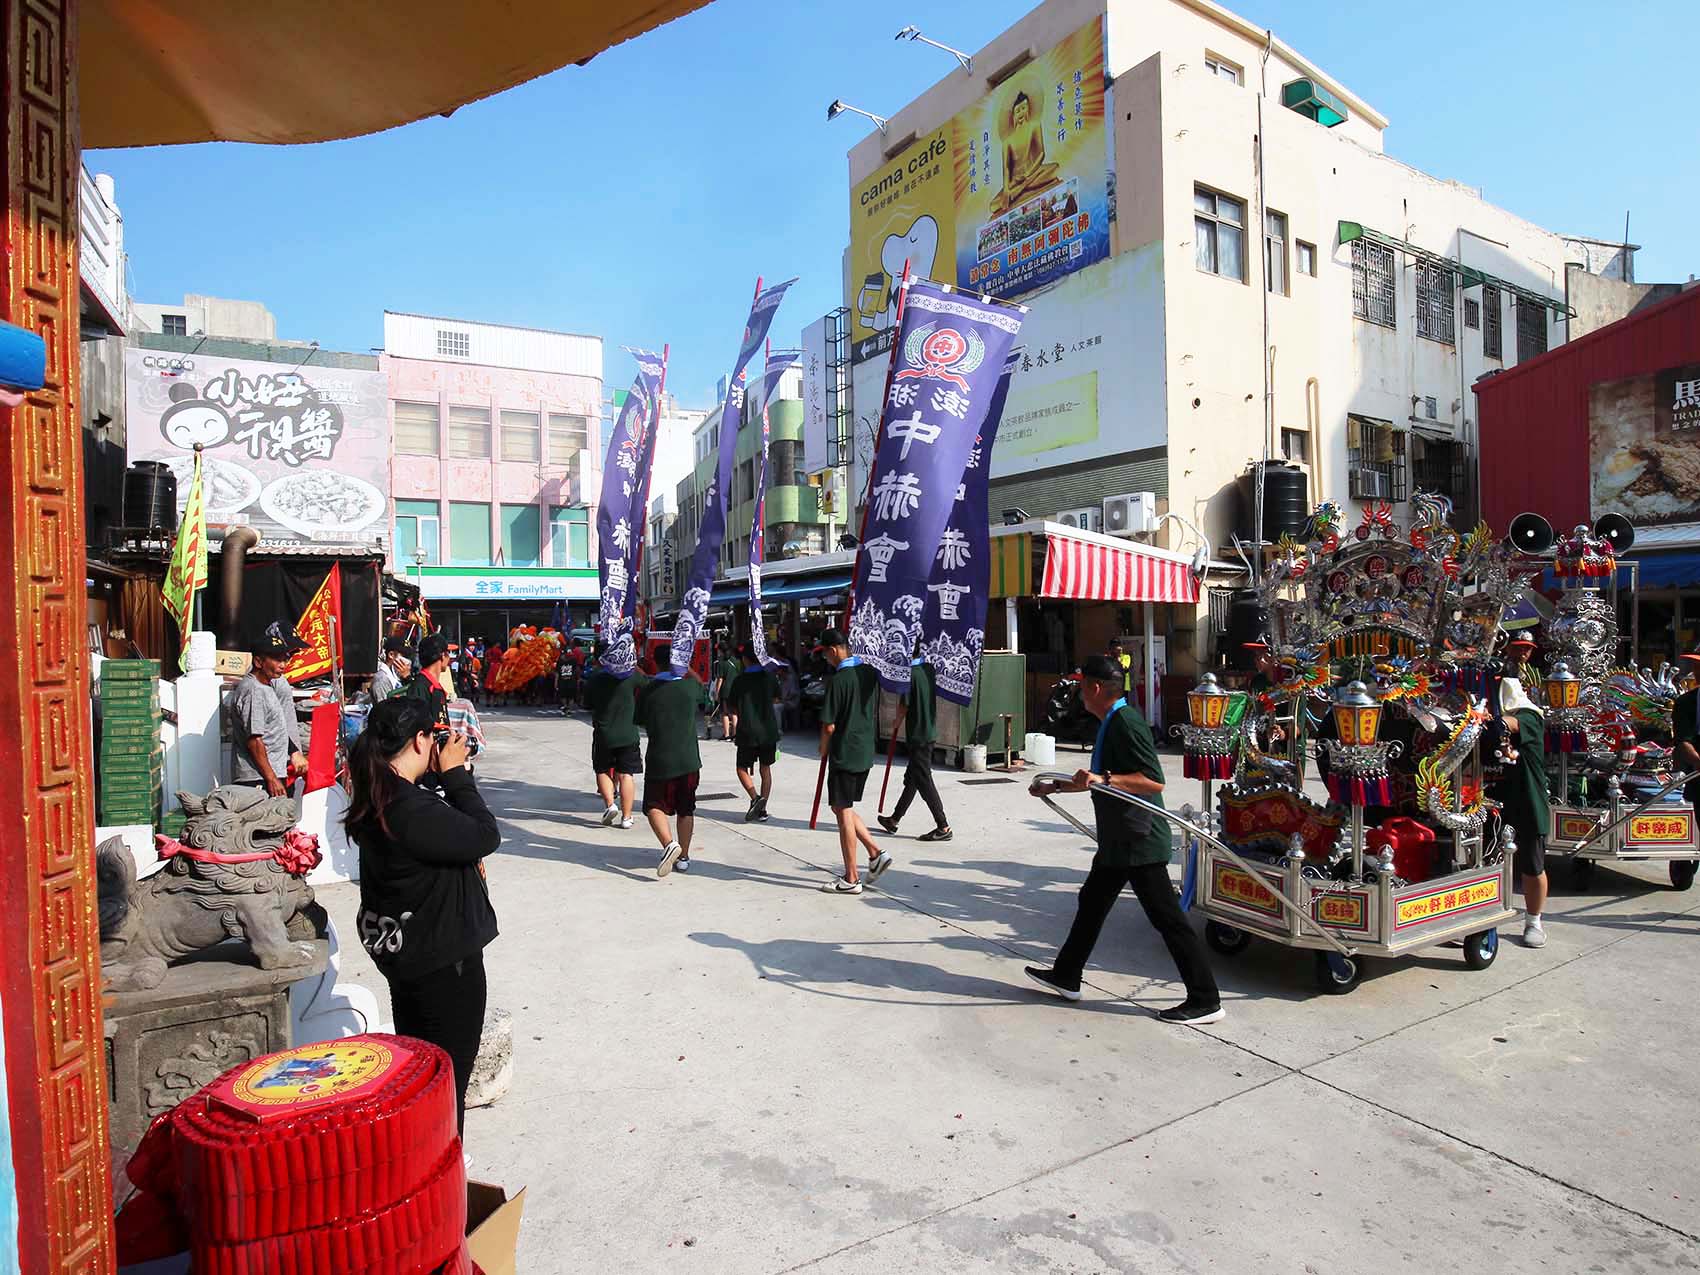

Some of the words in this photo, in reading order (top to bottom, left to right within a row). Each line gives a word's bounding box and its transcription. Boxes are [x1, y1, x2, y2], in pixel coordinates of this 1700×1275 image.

[861, 168, 903, 206] cama
[908, 131, 946, 174] café
[1008, 212, 1089, 265] 南無阿彌陀佛
[1021, 343, 1065, 372] 春水堂
[233, 407, 339, 465] 干貝醬
[475, 581, 503, 594] 全家
[508, 584, 563, 595] FamilyMart
